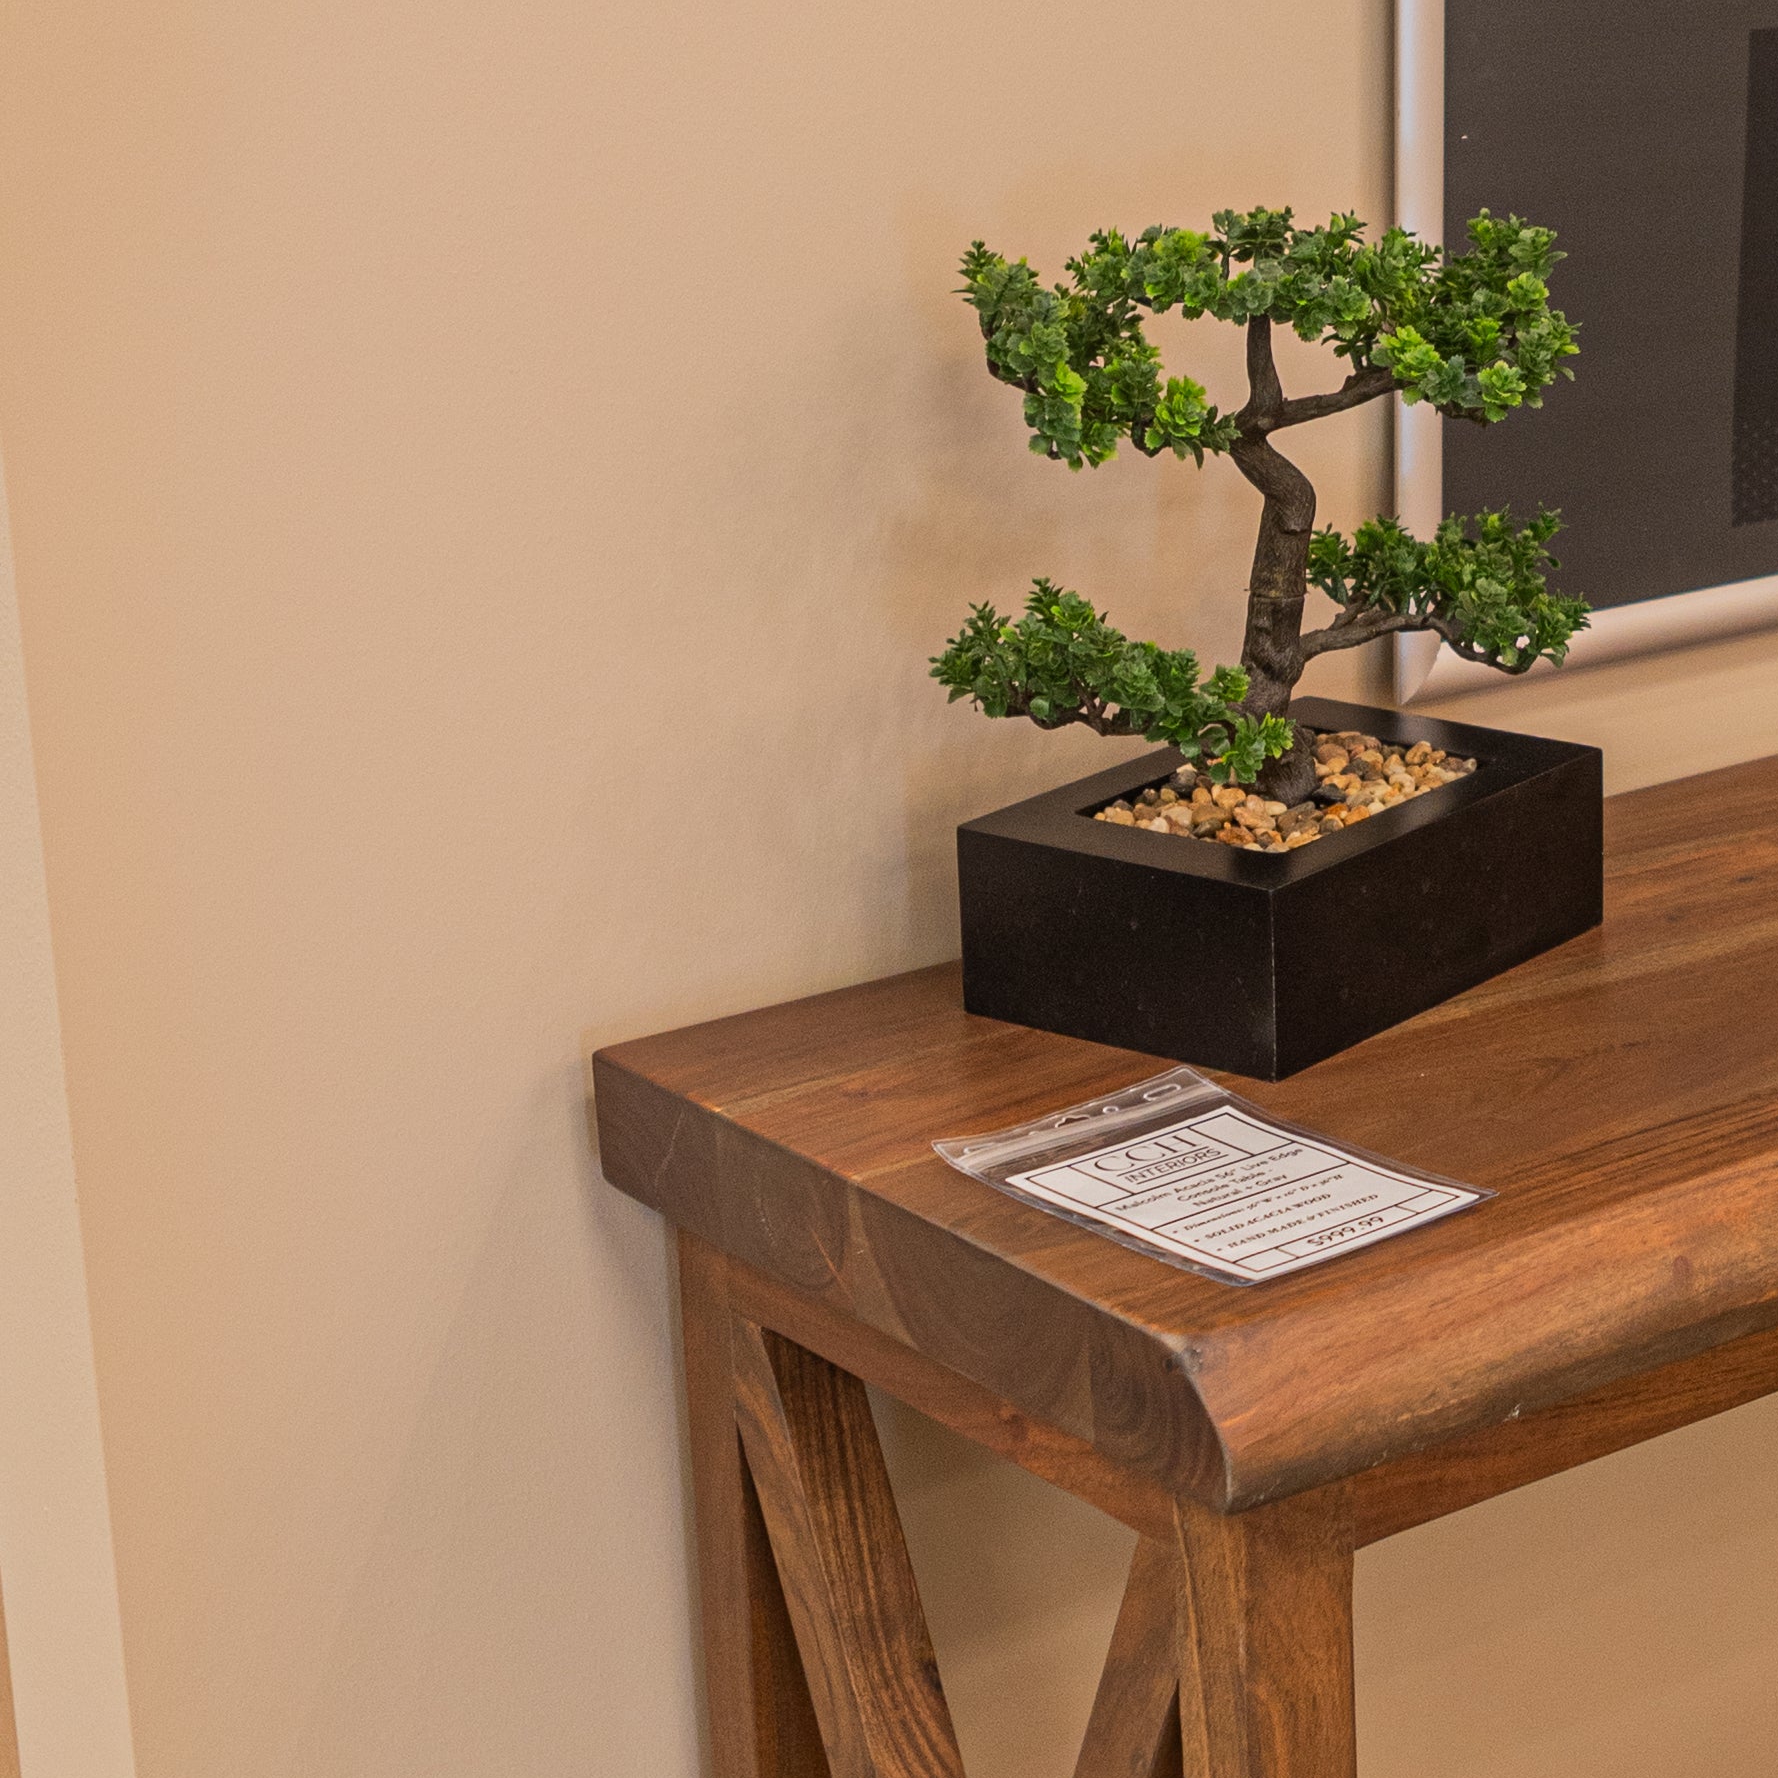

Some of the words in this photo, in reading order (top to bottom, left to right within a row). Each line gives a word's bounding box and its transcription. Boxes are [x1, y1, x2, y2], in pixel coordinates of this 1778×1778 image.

[1094, 1135, 1198, 1171] CCH
[1125, 1148, 1221, 1183] INTERIORS
[1115, 1191, 1172, 1211] Malcolm
[1173, 1176, 1212, 1193] Acacia
[1241, 1158, 1269, 1171] Live
[1268, 1148, 1304, 1163] Edge
[1177, 1184, 1226, 1202] Console
[1228, 1170, 1266, 1187] Table
[1193, 1188, 1243, 1207] Natural
[1255, 1174, 1288, 1187] Gray
[1205, 1223, 1244, 1241] SOLID
[1248, 1206, 1293, 1227] ACACIA
[1294, 1193, 1331, 1209] WOOD
[1227, 1232, 1266, 1249] HAND
[1267, 1218, 1306, 1235] MADE
[1316, 1193, 1379, 1219] FINISHED
[1307, 1216, 1384, 1247] $999.99
